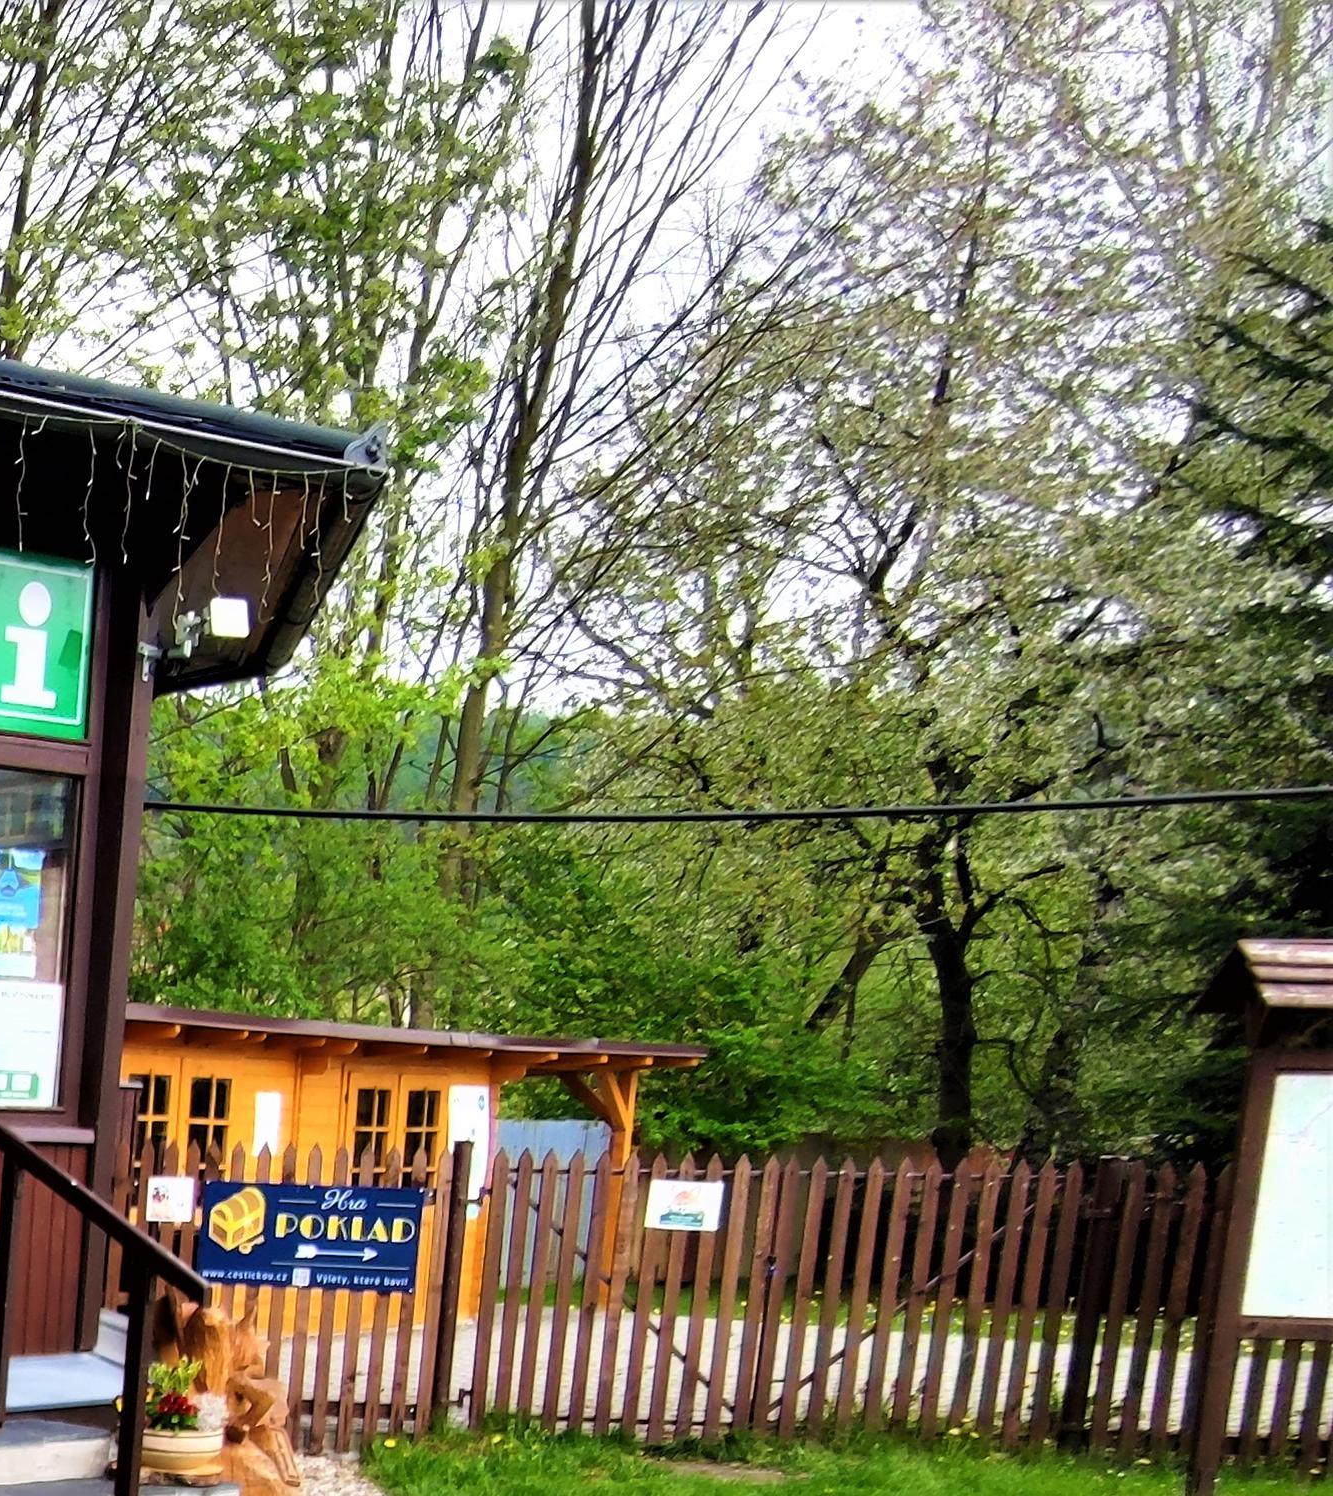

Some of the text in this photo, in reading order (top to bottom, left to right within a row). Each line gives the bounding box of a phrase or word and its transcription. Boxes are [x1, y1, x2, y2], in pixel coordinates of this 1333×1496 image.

[321, 1188, 368, 1211] Hra
[275, 1213, 416, 1243] POKLAD
[316, 1273, 350, 1286] Výlety,
[353, 1274, 380, 1286] které
